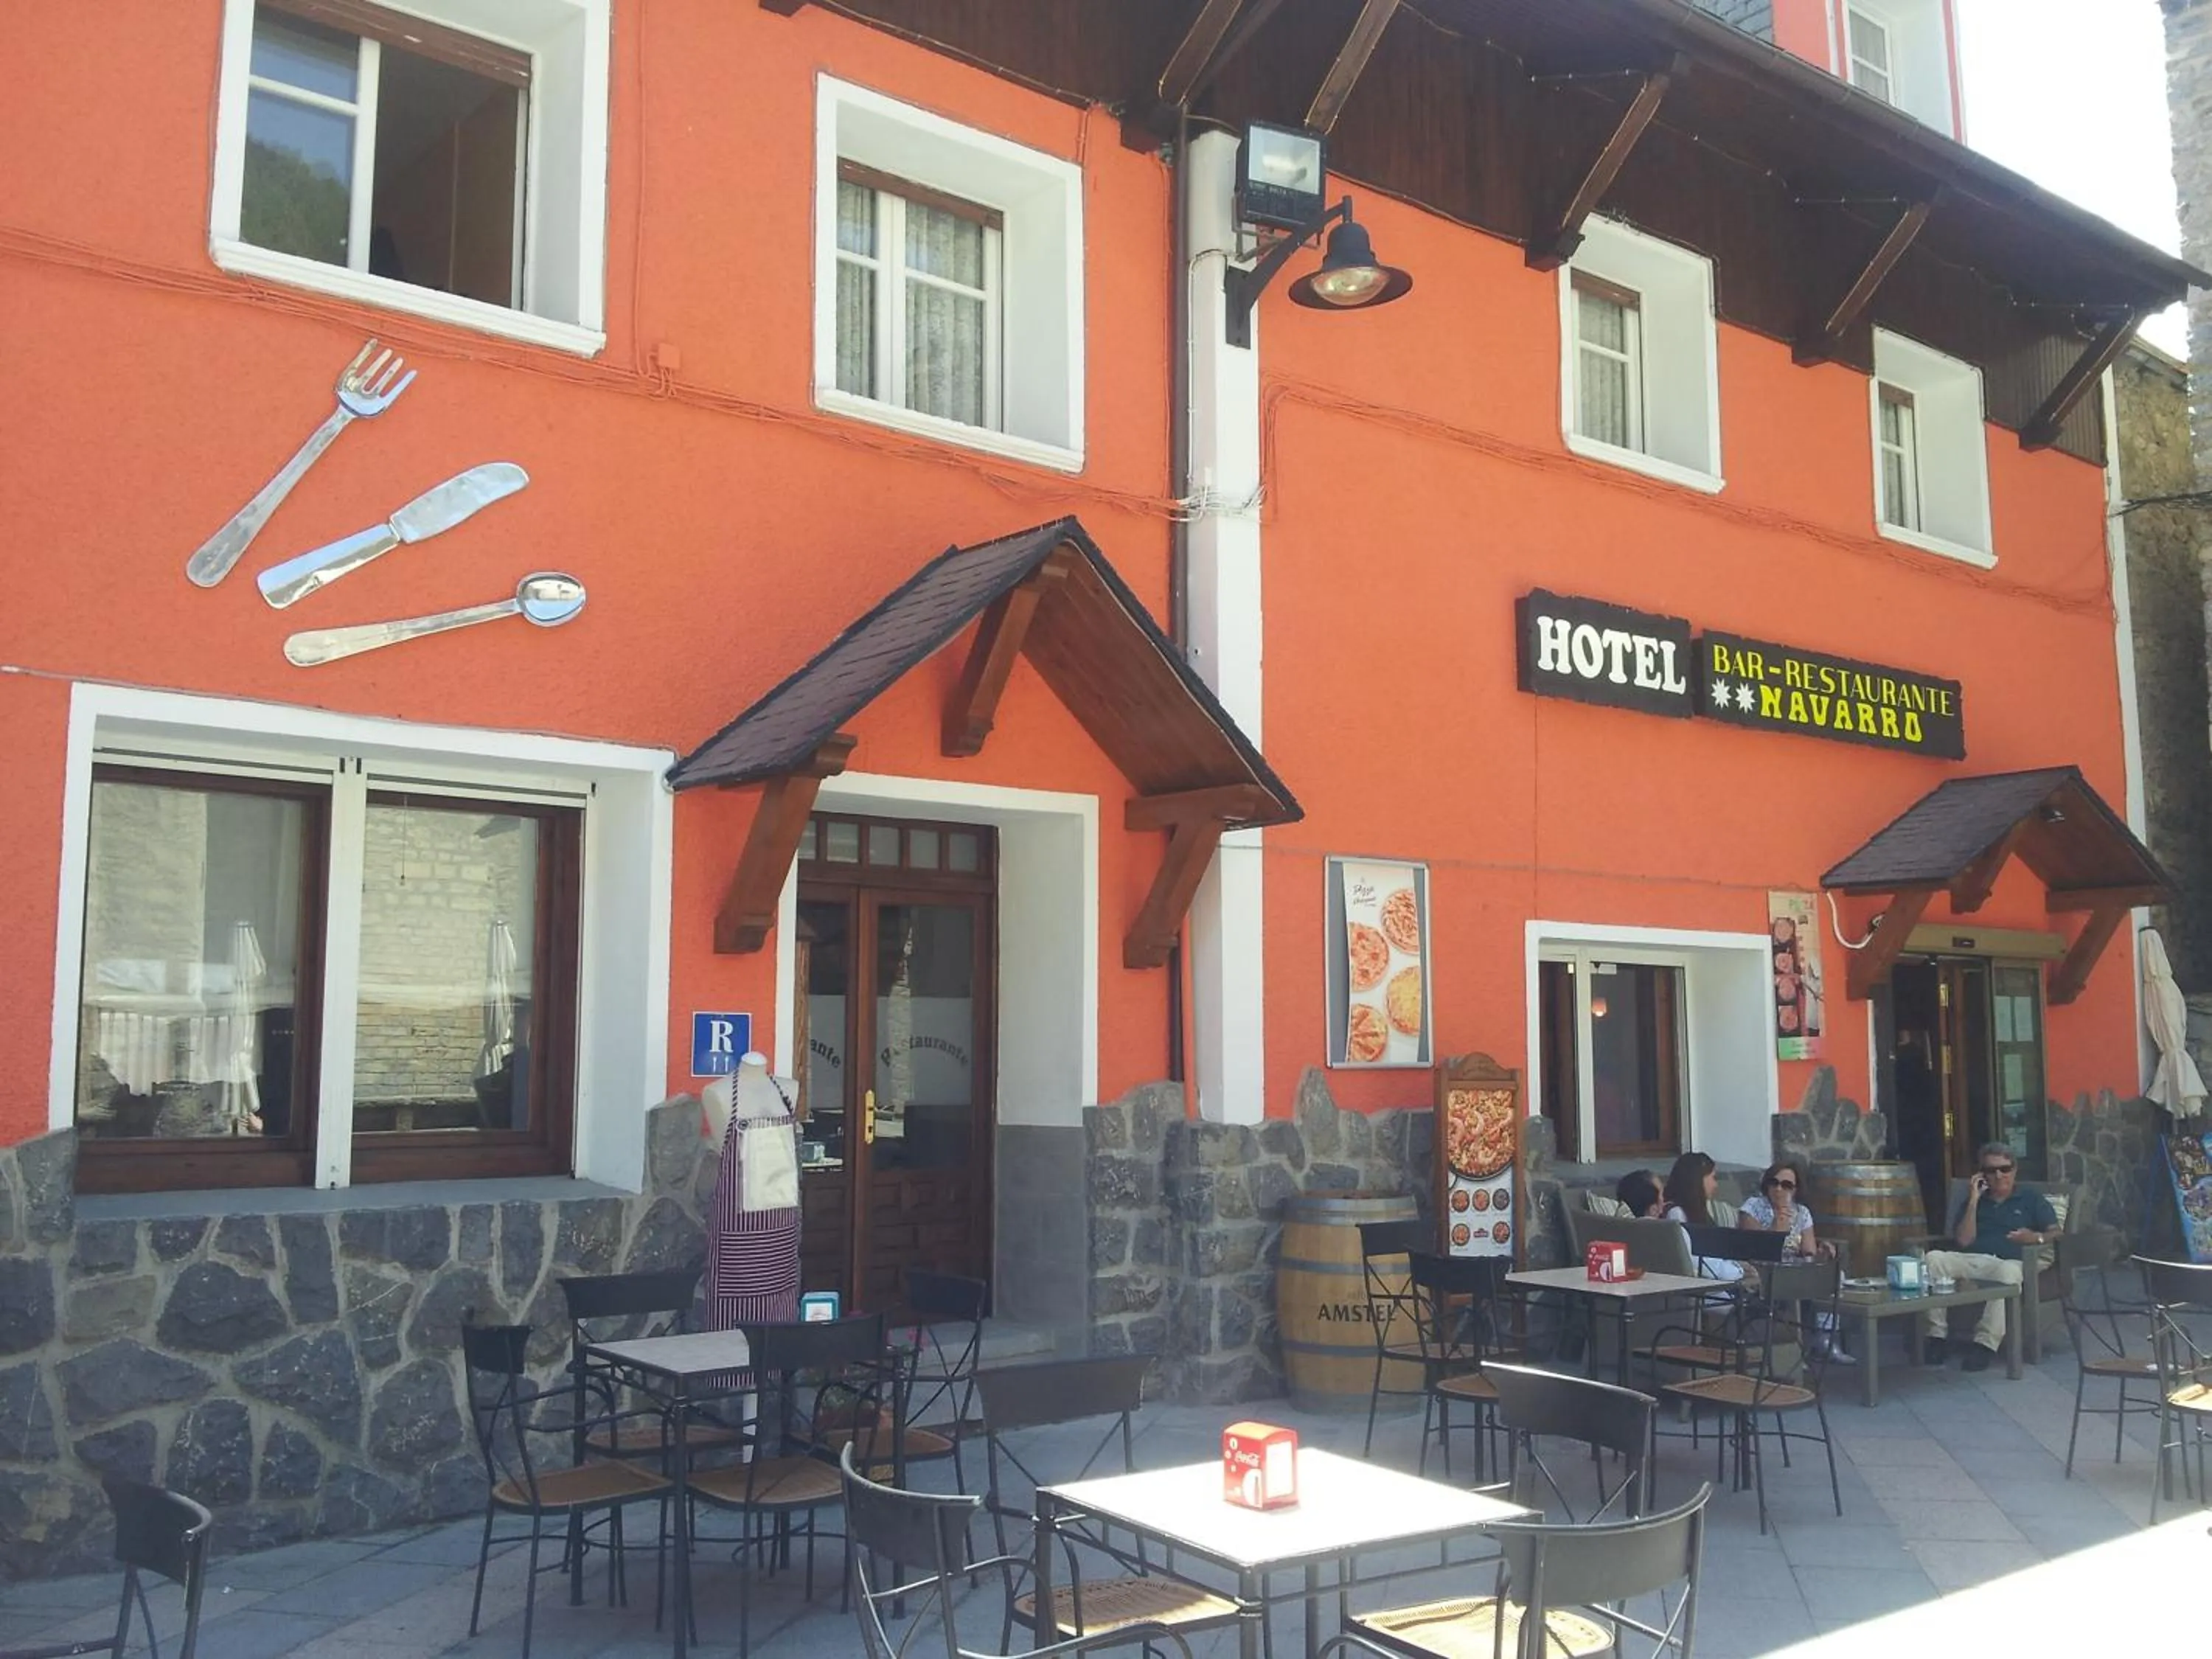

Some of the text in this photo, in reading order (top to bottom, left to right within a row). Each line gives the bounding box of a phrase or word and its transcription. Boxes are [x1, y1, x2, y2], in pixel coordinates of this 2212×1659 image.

[1537, 616, 1686, 695] HOTEL
[1713, 644, 1955, 716] BAR-RESTAURANTE
[1759, 684, 1923, 742] NAVARRO
[709, 1020, 734, 1053] R
[1318, 1303, 1397, 1322] AMSTEL
